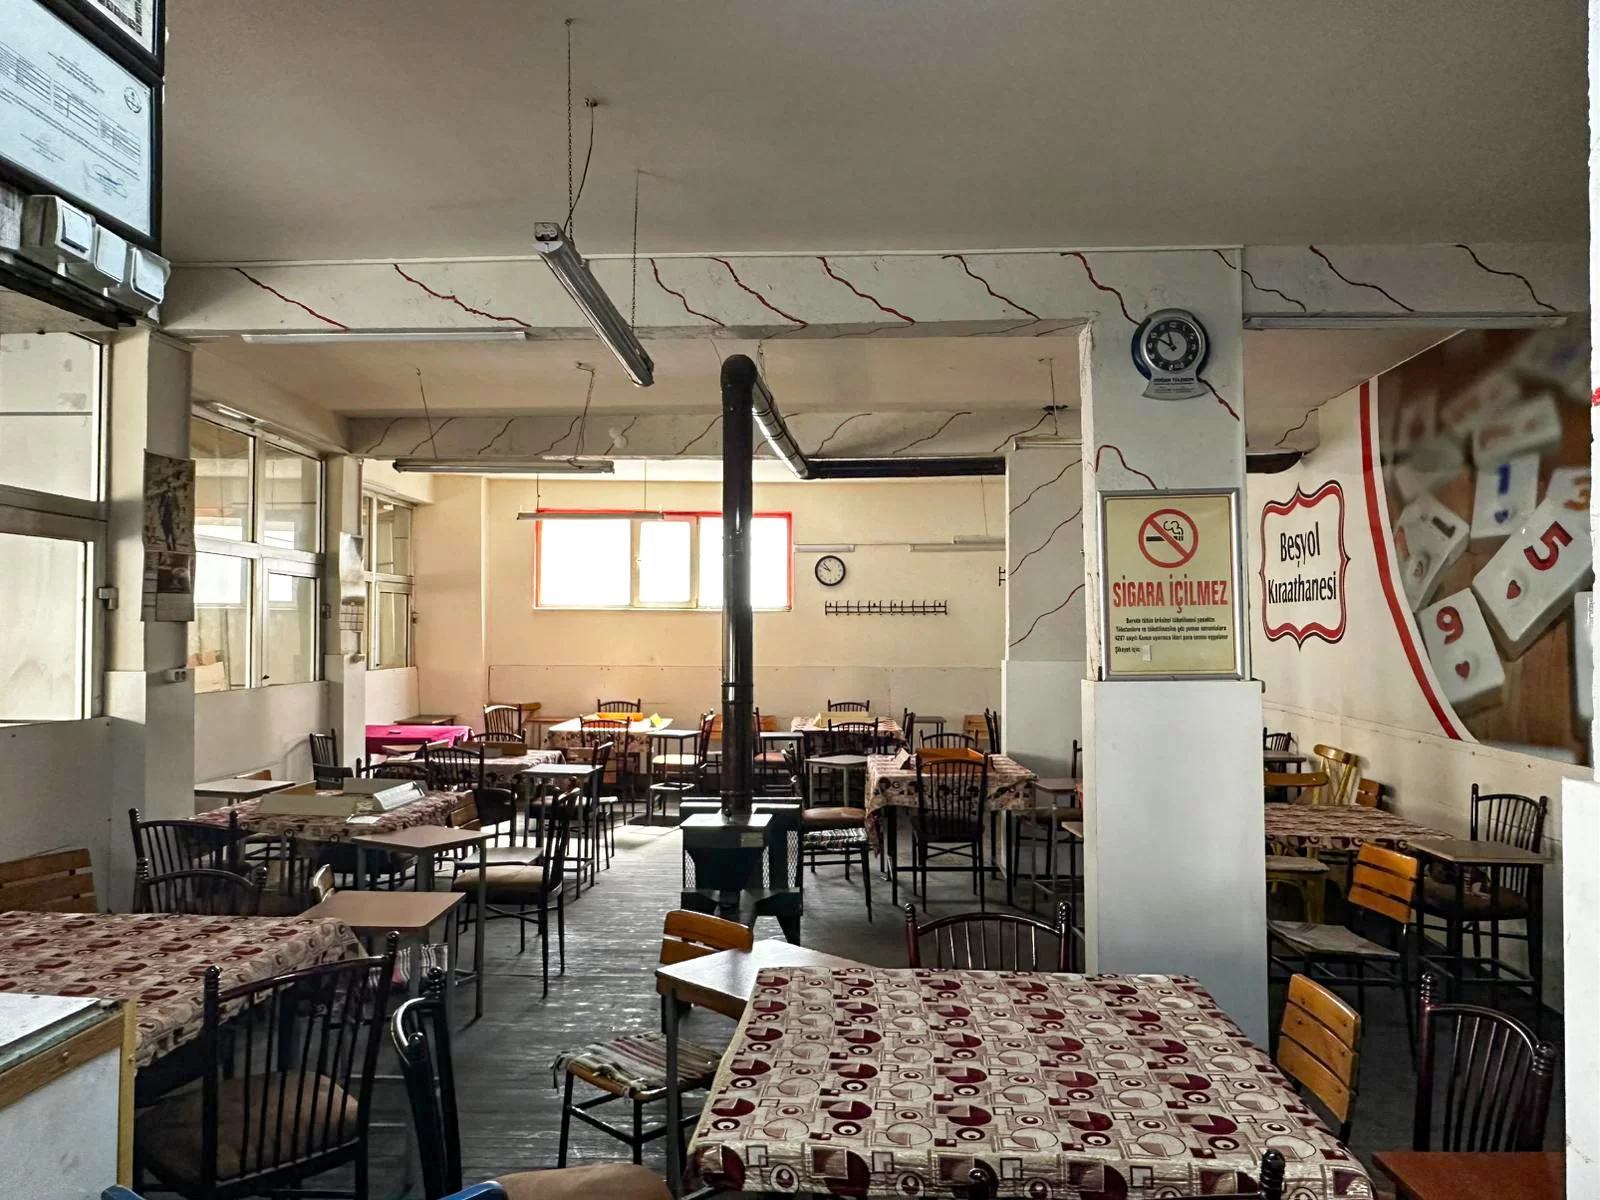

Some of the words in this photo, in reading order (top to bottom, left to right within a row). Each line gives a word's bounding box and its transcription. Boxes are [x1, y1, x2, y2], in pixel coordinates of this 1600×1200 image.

[1496, 463, 1511, 495] 1
[1280, 521, 1320, 568] Beşyol
[1523, 521, 1573, 571] 5
[1113, 575, 1164, 607] SİGARA
[1169, 574, 1228, 613] İÇİLMEZ
[1268, 571, 1336, 604] Kıraathanesi
[1436, 605, 1464, 645] 9
